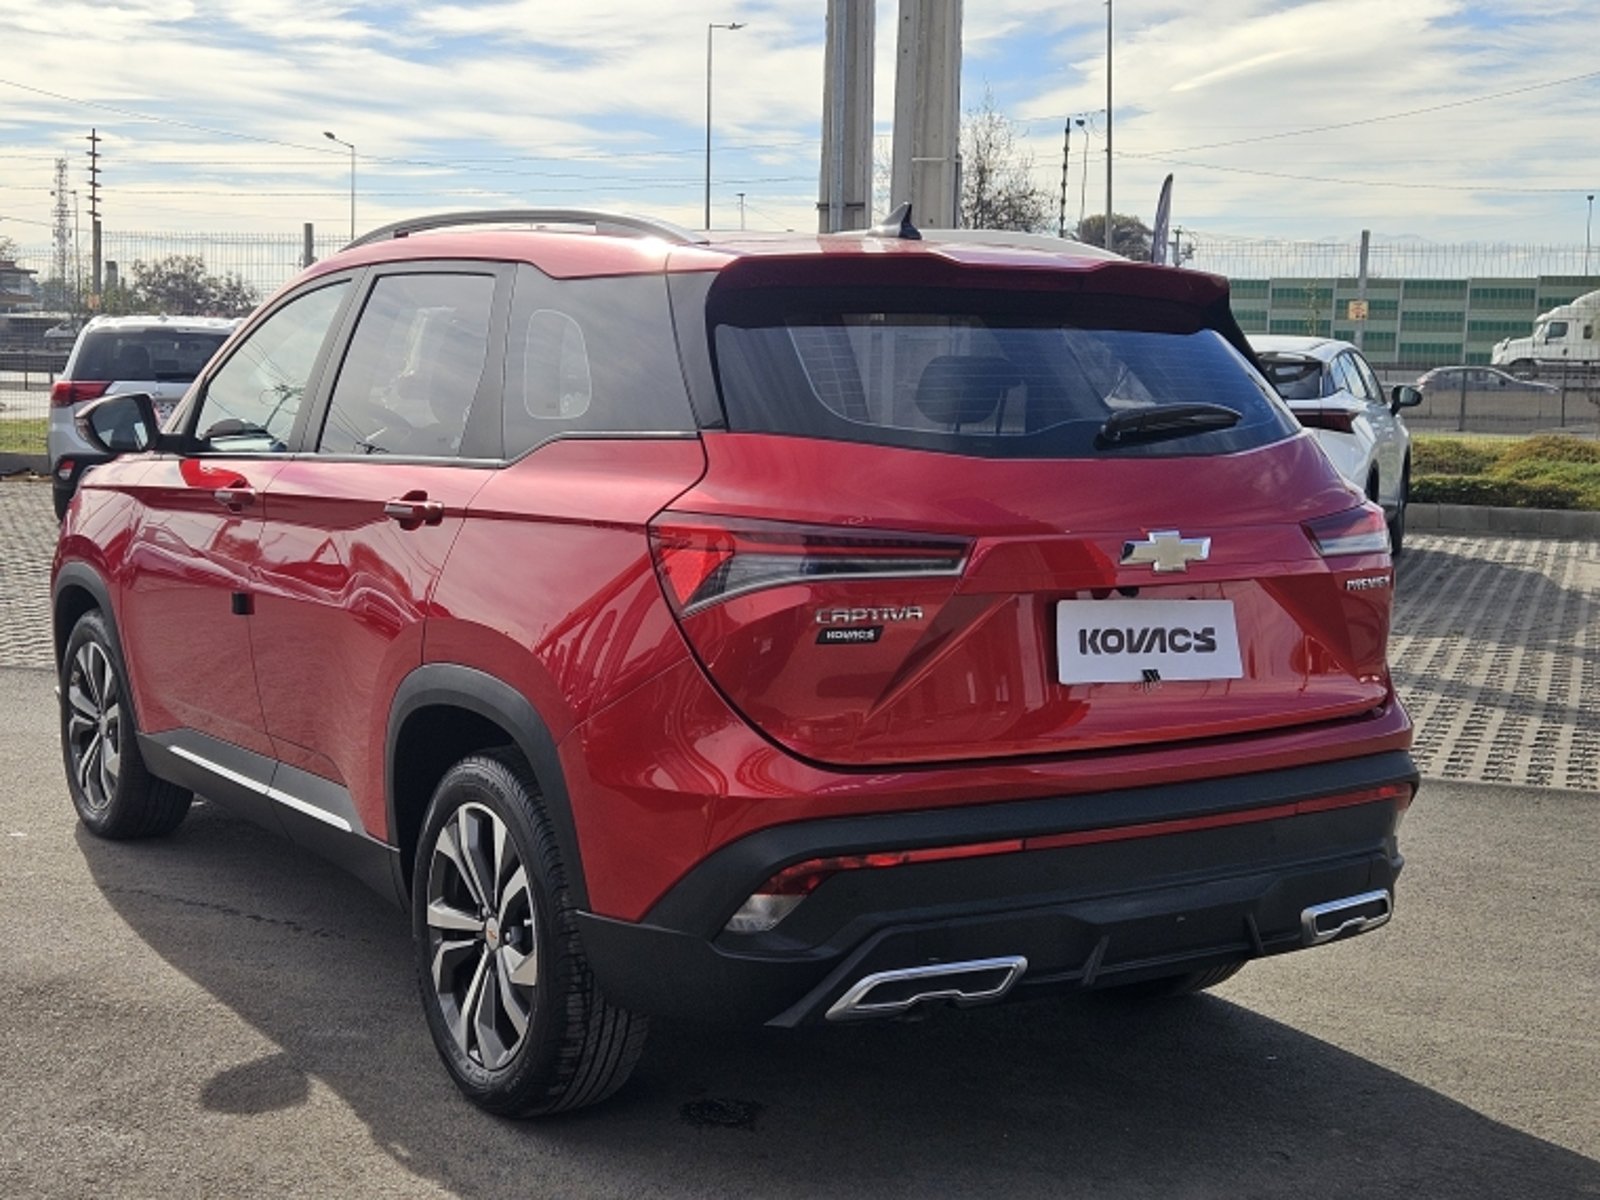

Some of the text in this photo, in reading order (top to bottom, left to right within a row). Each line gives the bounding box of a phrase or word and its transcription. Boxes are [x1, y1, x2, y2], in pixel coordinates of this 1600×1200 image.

[815, 606, 924, 624] CAPTIVA
[826, 629, 875, 640] KOVACS
[1079, 627, 1217, 655] KOVACS
